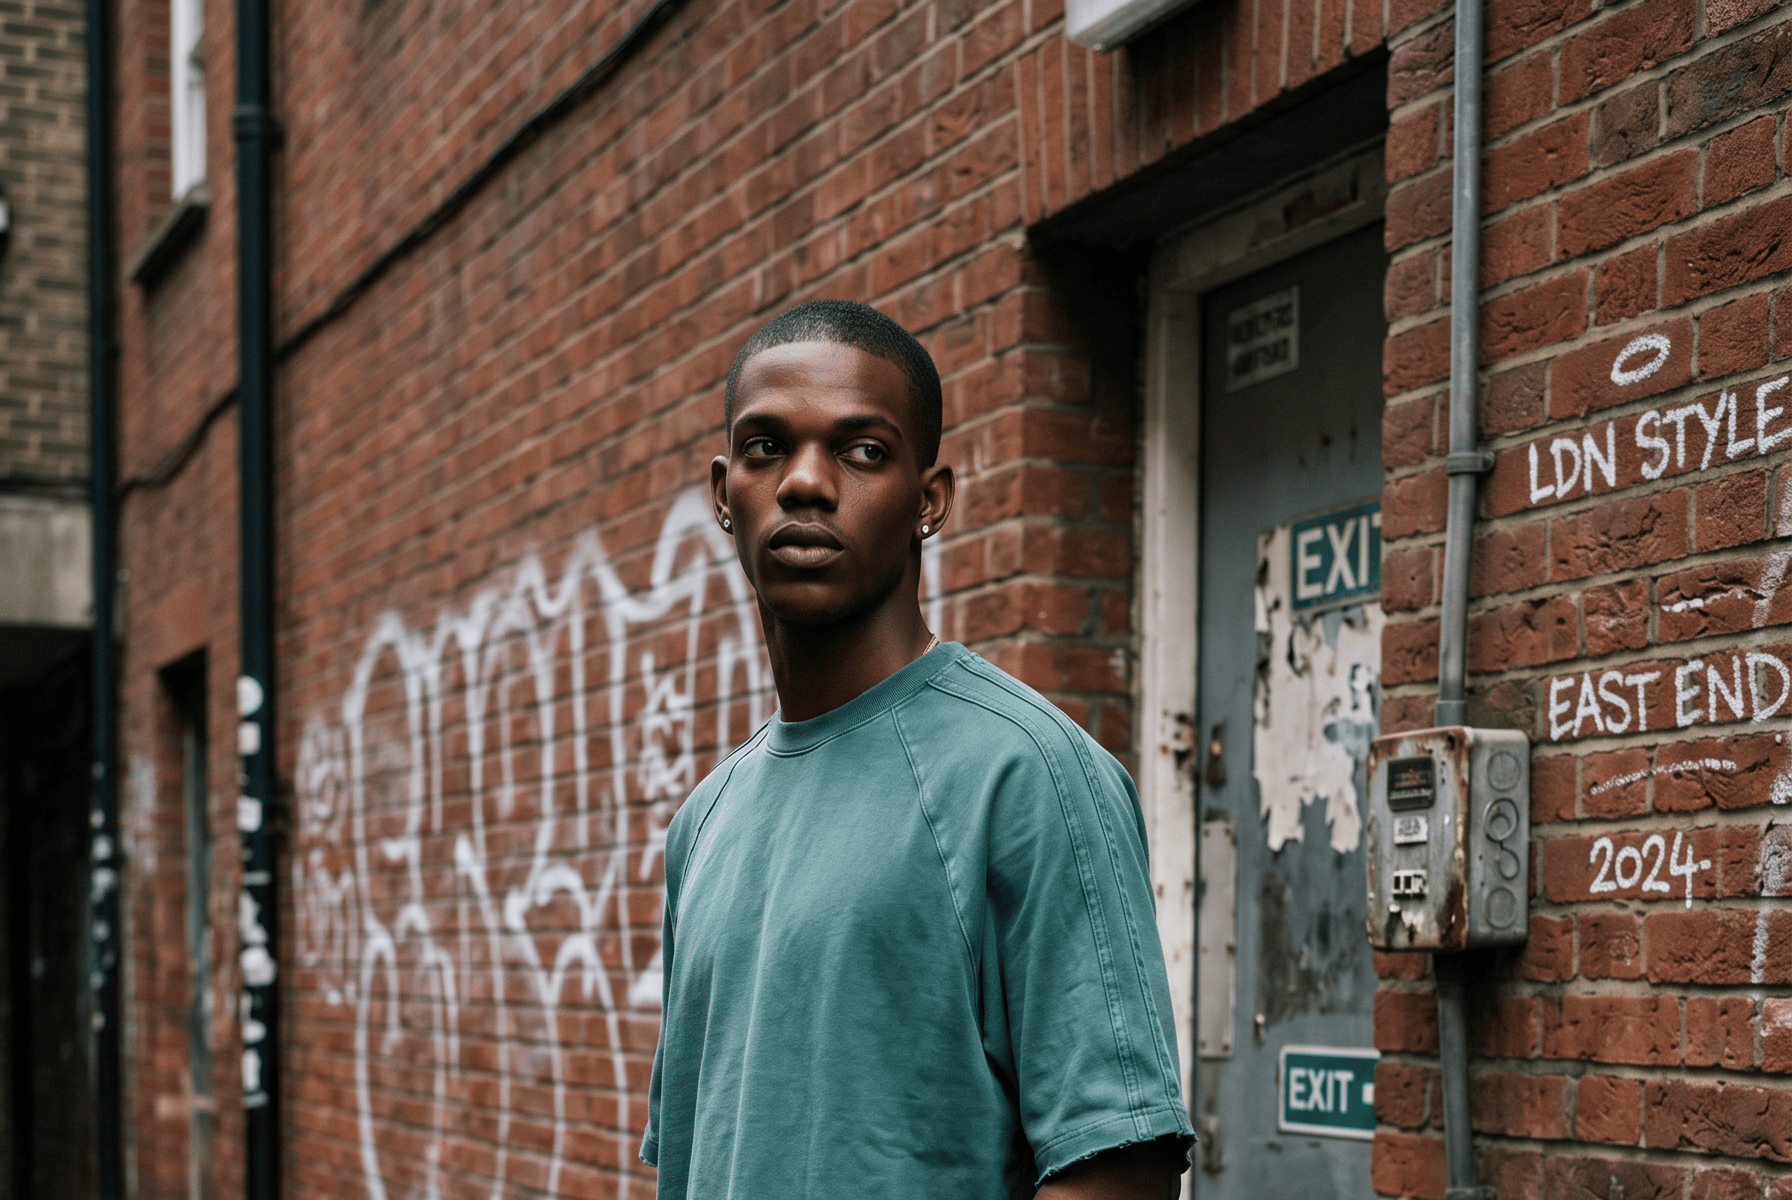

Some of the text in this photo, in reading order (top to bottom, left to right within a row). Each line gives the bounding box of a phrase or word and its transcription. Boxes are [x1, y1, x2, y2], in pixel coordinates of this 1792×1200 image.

[1528, 375, 1792, 505] LDN STYLE
[1297, 511, 1381, 600] EXI
[1548, 652, 1791, 741] EAST END
[1288, 1066, 1354, 1114] EXIT
